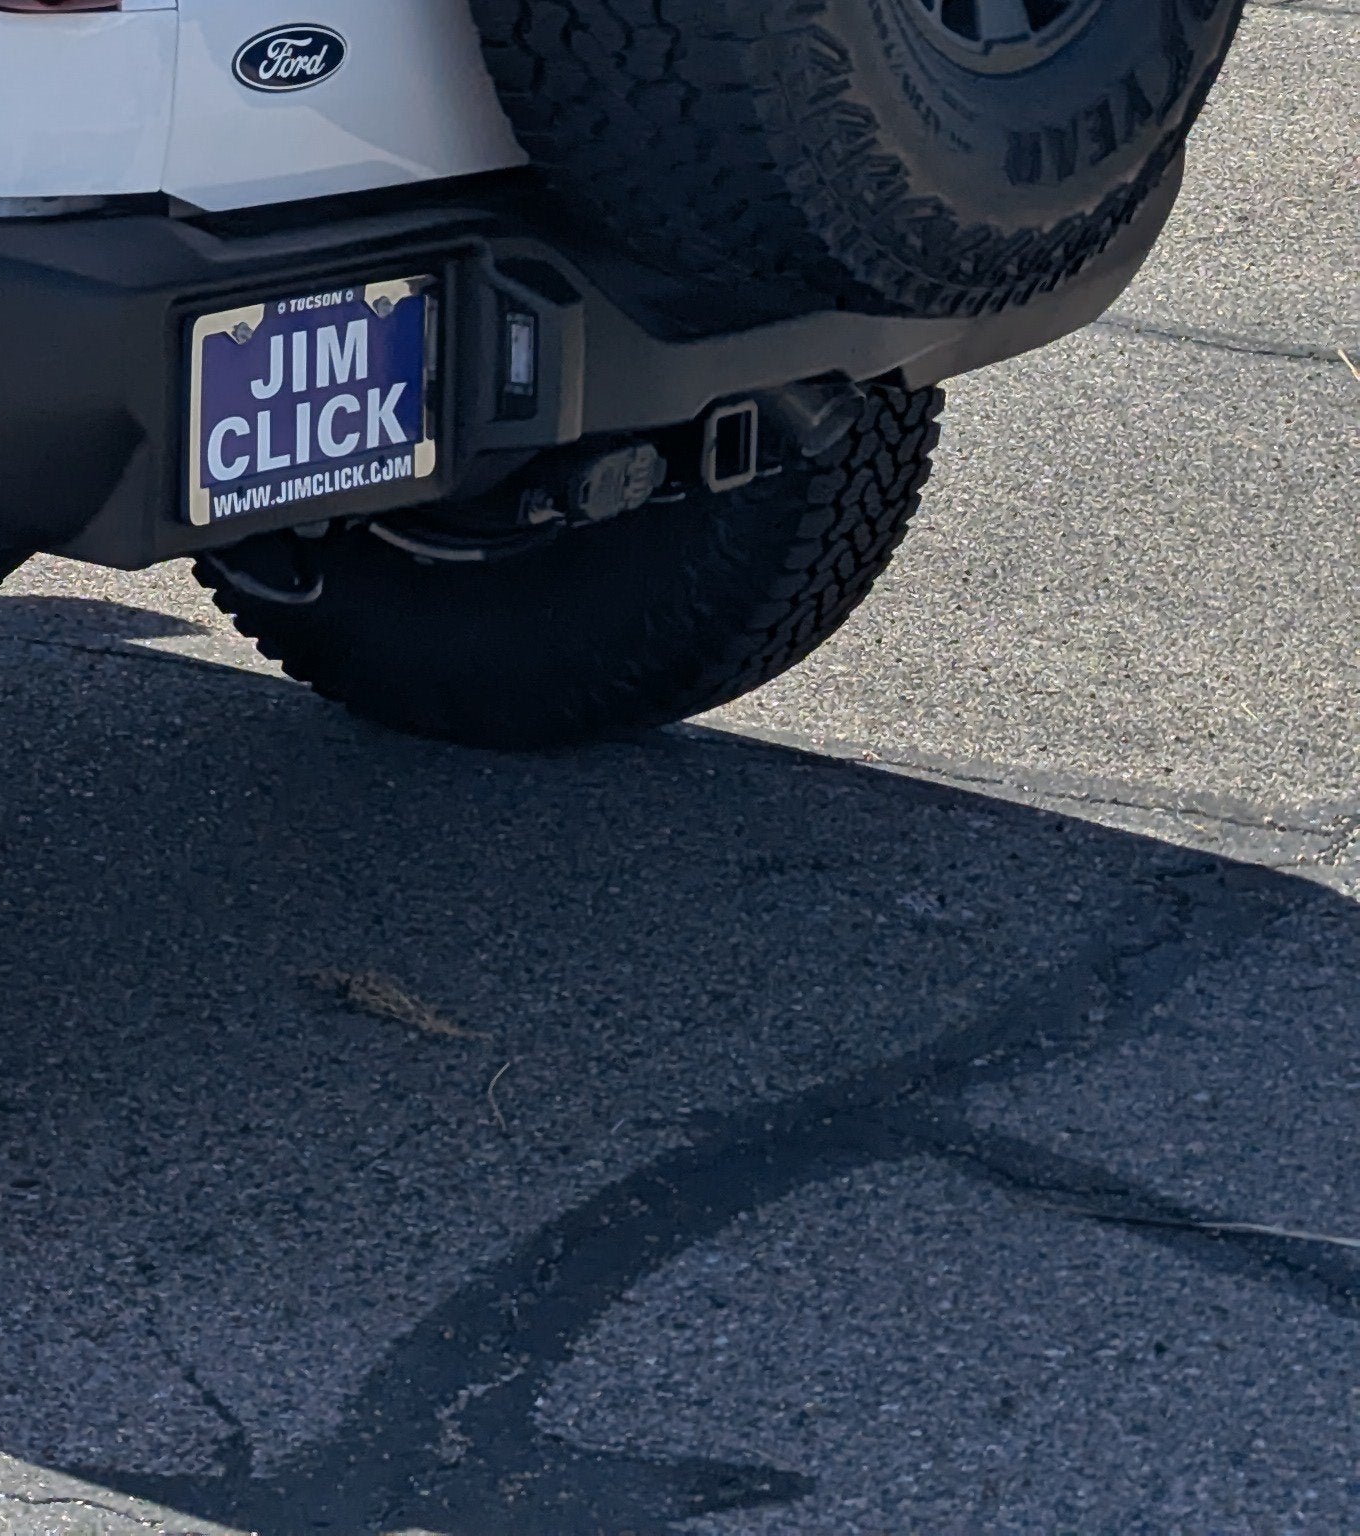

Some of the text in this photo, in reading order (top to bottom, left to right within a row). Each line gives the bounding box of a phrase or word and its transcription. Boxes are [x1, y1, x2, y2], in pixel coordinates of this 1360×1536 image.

[258, 37, 329, 80] Ford
[289, 290, 343, 313] TUCSON
[250, 318, 369, 400] JIM
[206, 382, 408, 482] CLICK
[213, 454, 412, 518] WWW.JIMCLICK.COM
